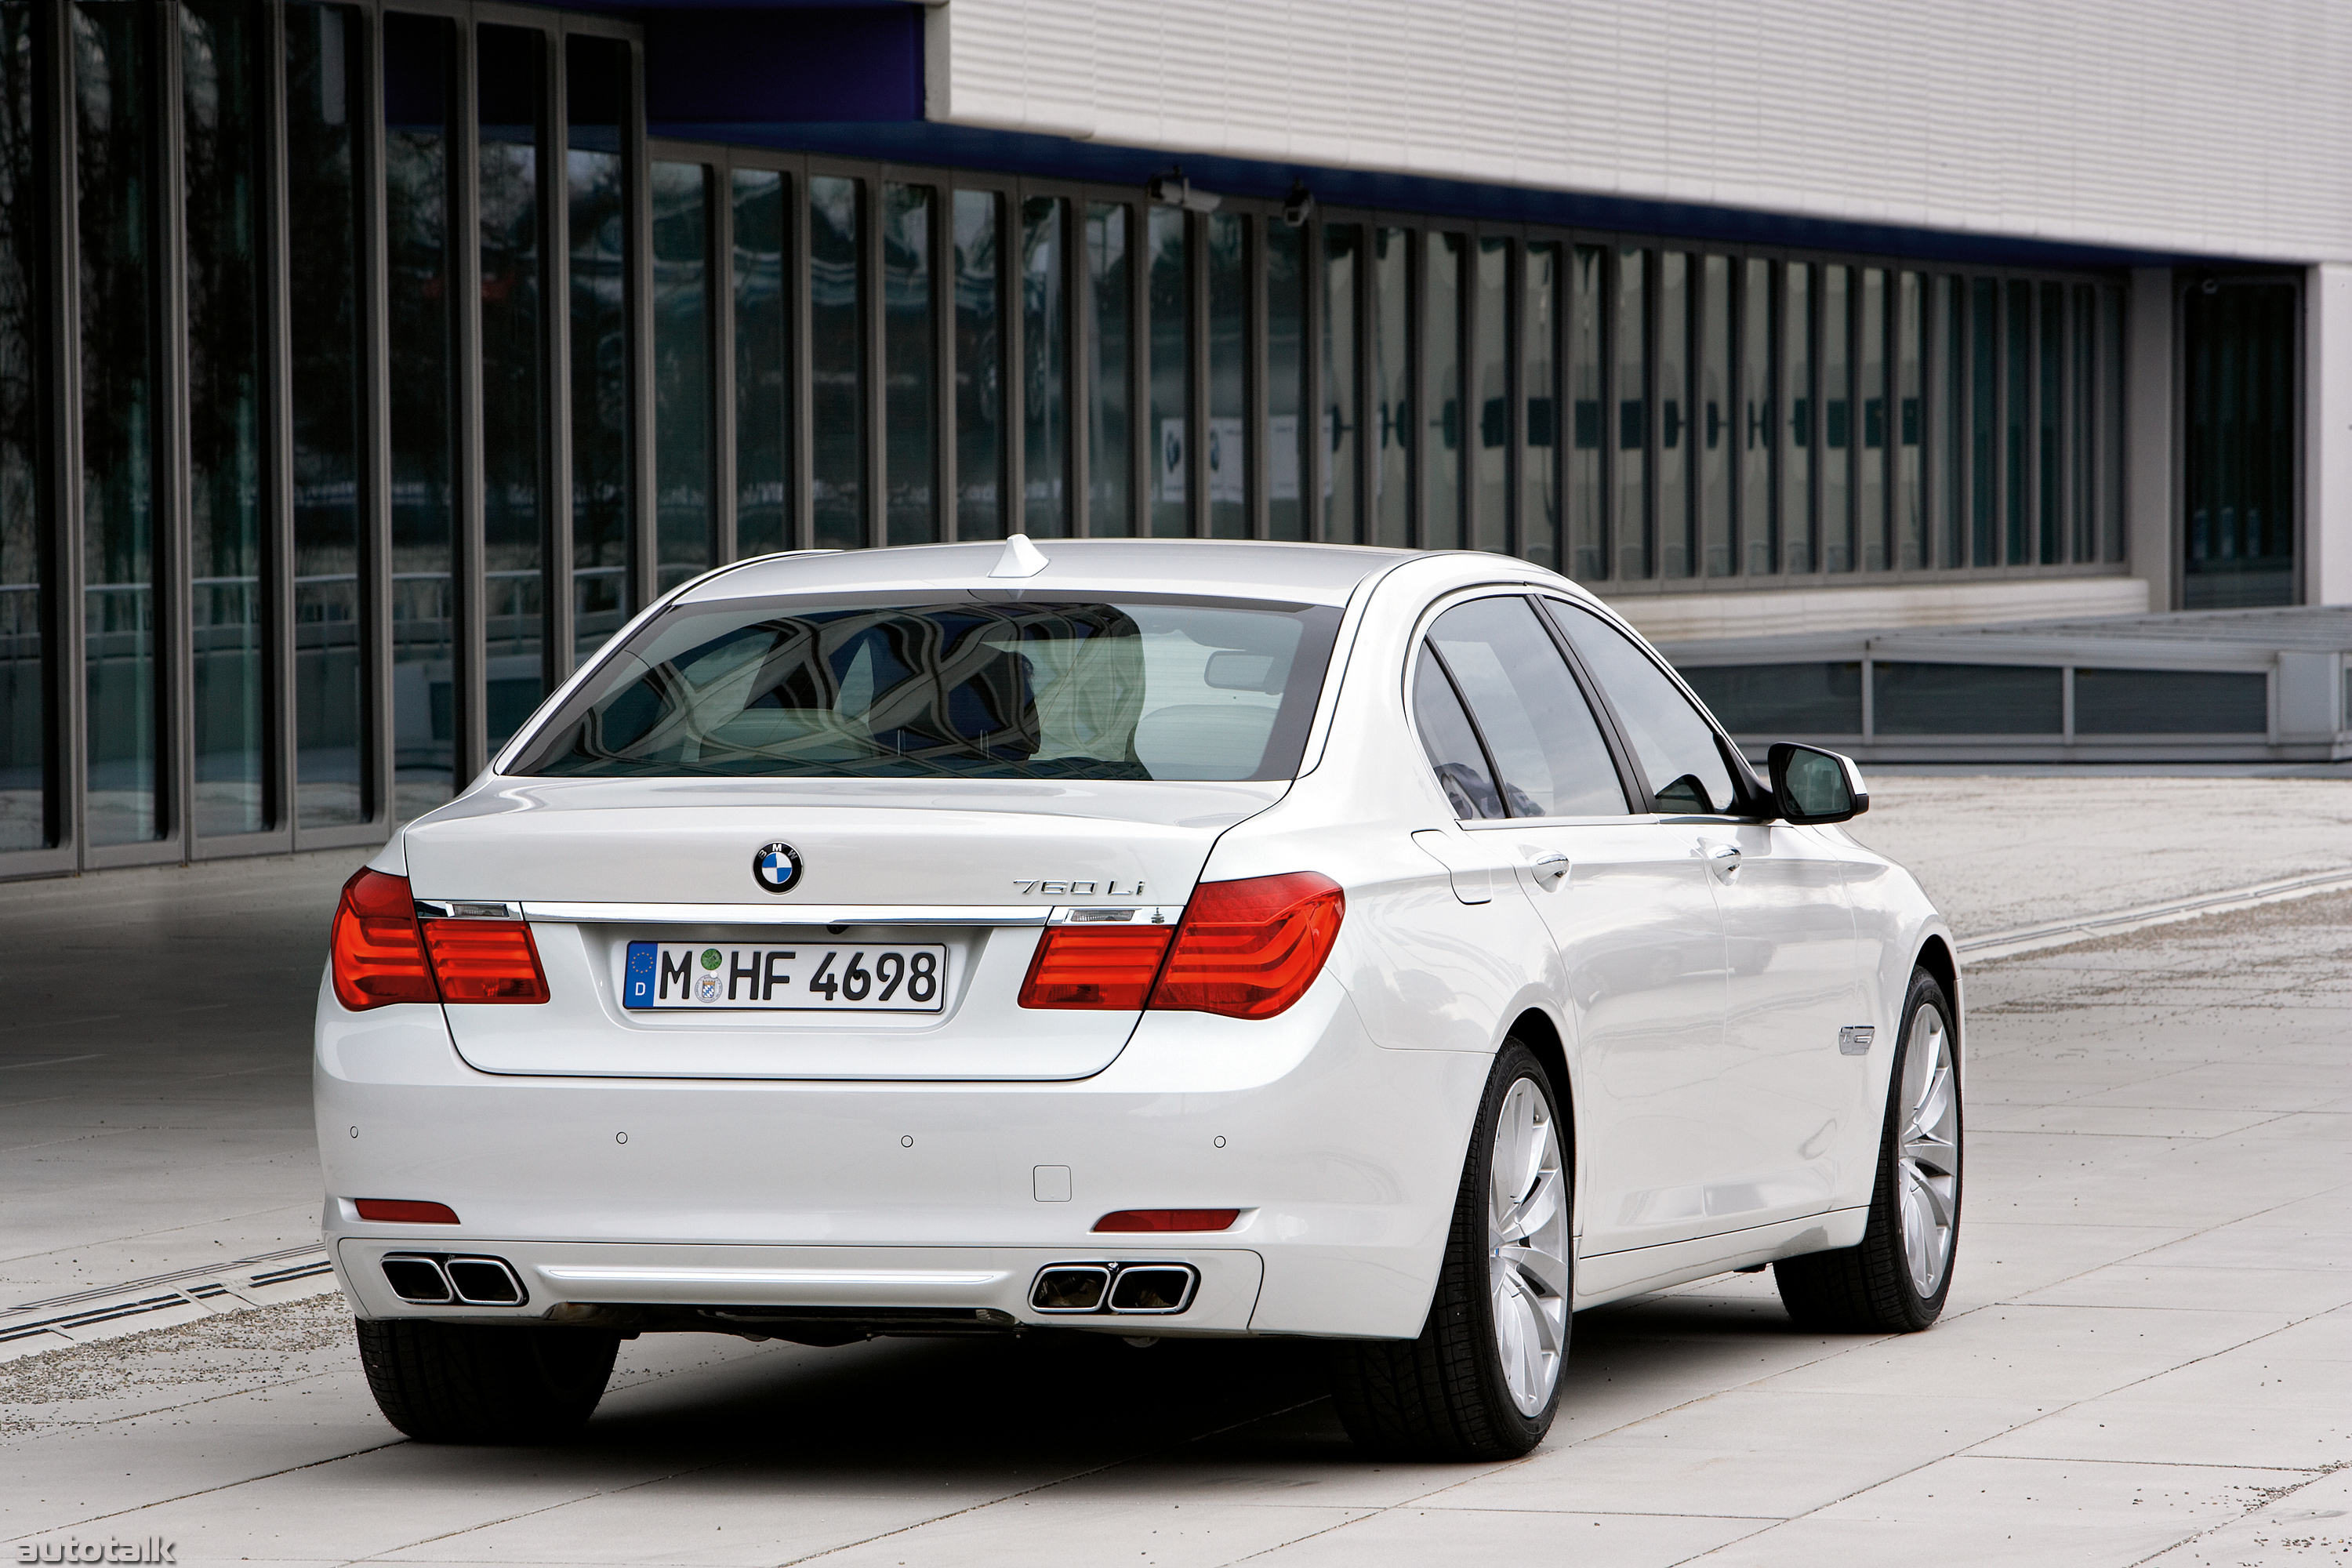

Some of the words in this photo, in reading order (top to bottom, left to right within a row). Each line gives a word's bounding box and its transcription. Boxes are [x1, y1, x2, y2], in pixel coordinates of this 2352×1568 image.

[757, 843, 798, 860] BMW
[1013, 879, 1098, 895] 760
[1107, 880, 1146, 895] Li
[659, 950, 693, 1000] M
[728, 951, 797, 1000] HF
[809, 952, 937, 1003] 4698
[634, 982, 646, 996] D
